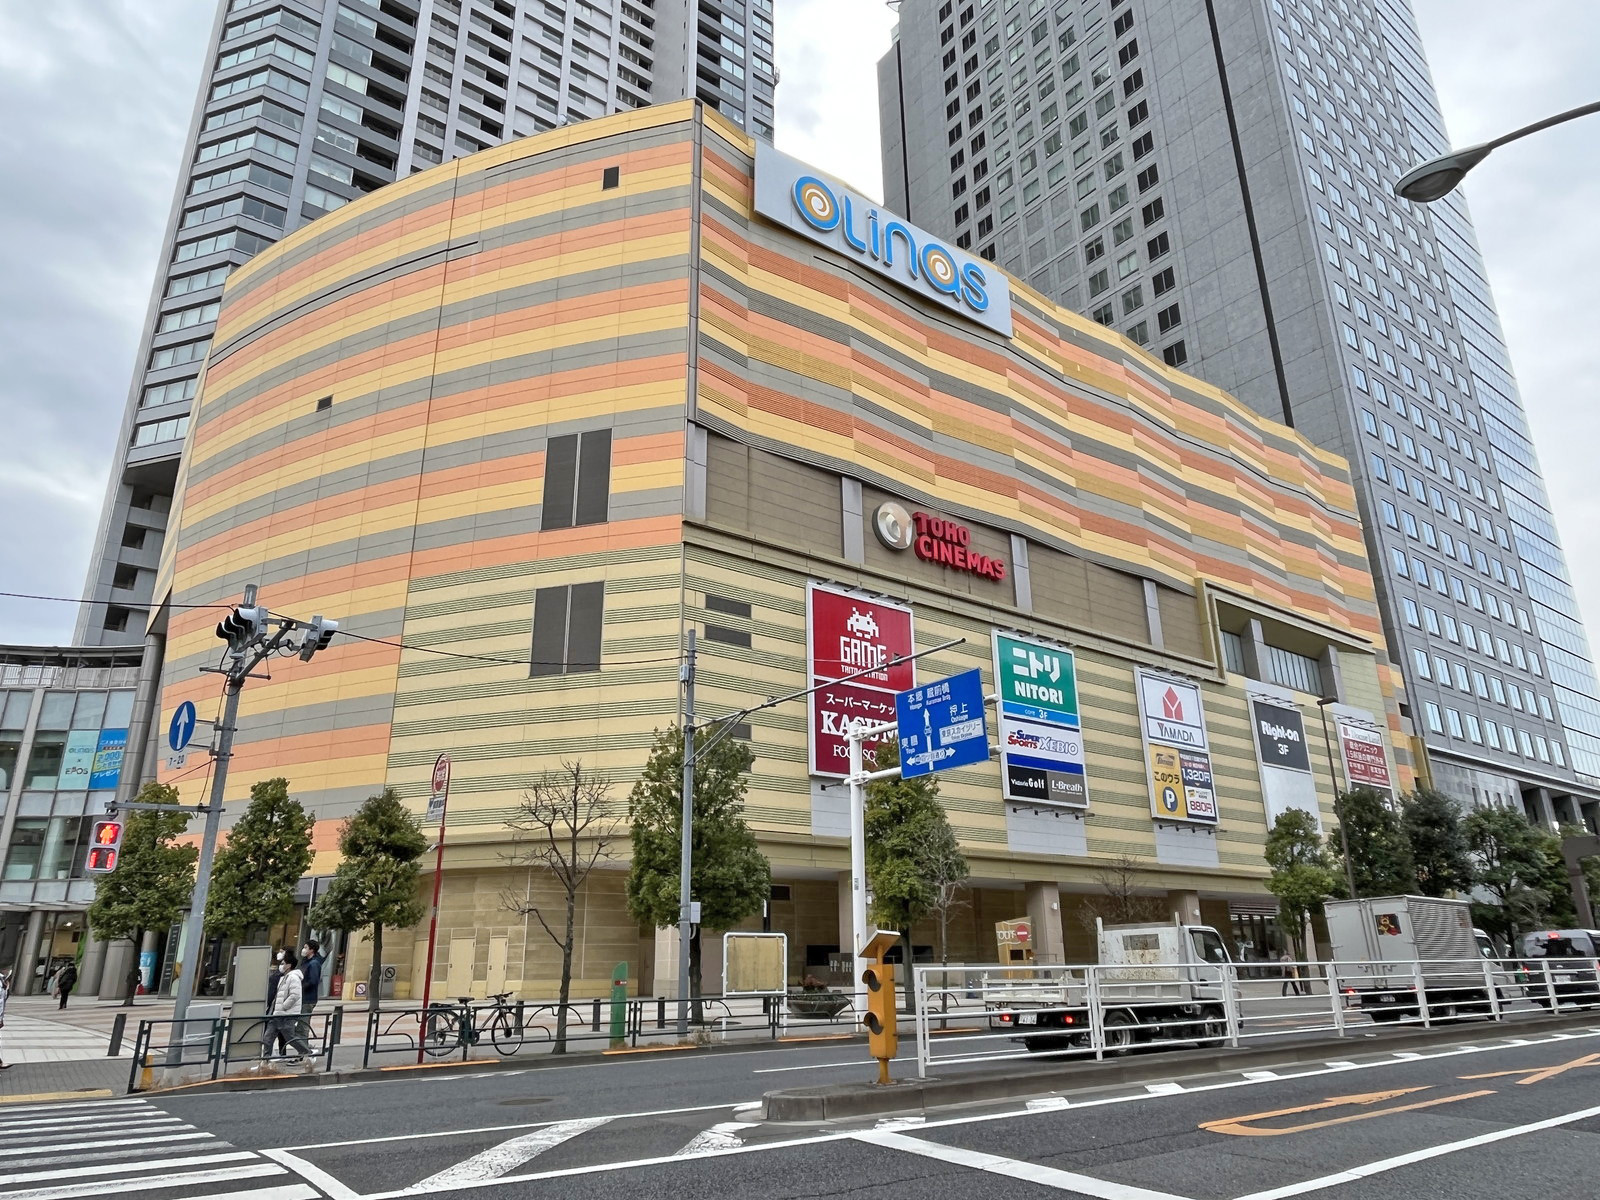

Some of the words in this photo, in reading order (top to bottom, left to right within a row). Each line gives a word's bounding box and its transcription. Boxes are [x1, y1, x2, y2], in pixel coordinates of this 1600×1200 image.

[912, 511, 971, 546] TOHO
[914, 535, 1007, 581] CINEMAS
[840, 635, 887, 672] GAME
[1012, 647, 1061, 683] ニトリ
[1014, 680, 1063, 705] NITORI
[1038, 709, 1048, 720] 3F
[1157, 722, 1194, 743] YAMADA
[1260, 720, 1300, 743] Right-on
[1008, 735, 1038, 749] SPORTS
[1039, 736, 1079, 756] XEBIO
[1277, 743, 1290, 756] 3F
[65, 766, 89, 775] EPOS
[1154, 771, 1180, 785] このウラ
[1182, 767, 1211, 783] 1,320円
[1051, 779, 1083, 792] L-Breath
[1190, 800, 1213, 814] 880円
